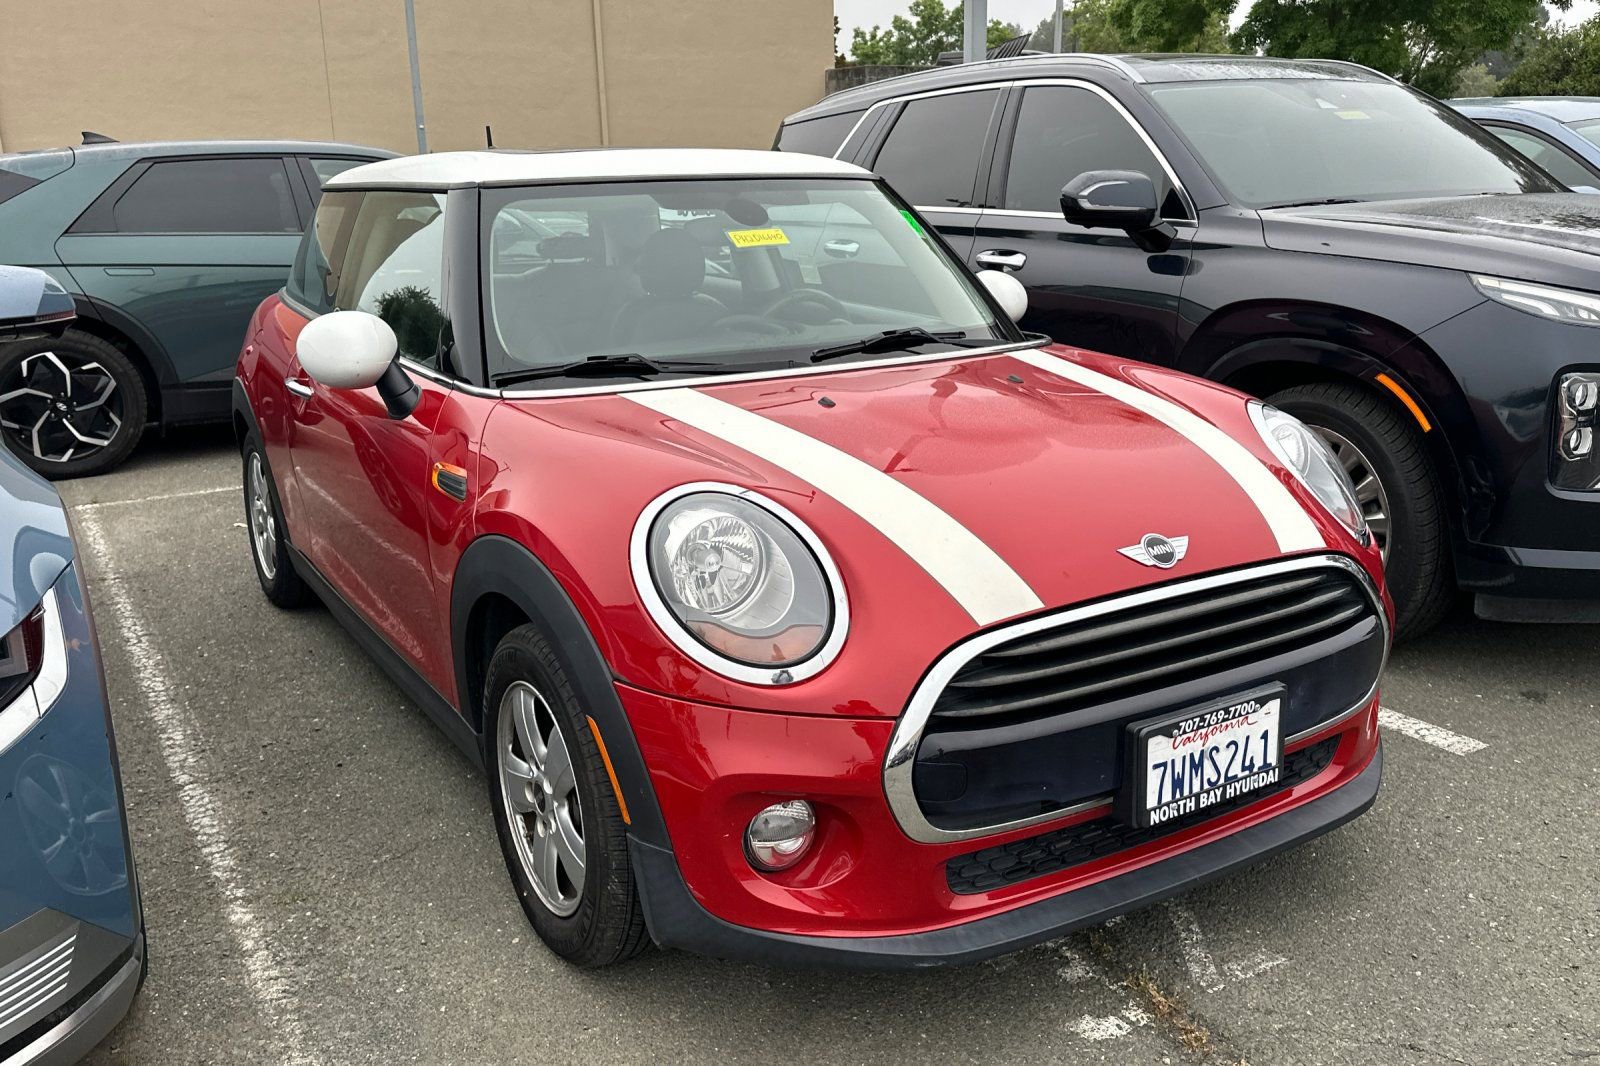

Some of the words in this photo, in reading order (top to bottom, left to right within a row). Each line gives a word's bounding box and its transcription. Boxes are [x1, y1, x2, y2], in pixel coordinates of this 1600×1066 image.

[1147, 543, 1173, 556] MINI
[1172, 714, 1258, 750] California
[1178, 700, 1255, 735] 707-769-7700
[1152, 729, 1273, 805] 7WMS241
[1150, 797, 1196, 826] NORTH
[1200, 787, 1223, 808] BAY
[1226, 767, 1279, 799] HYUNDAI
